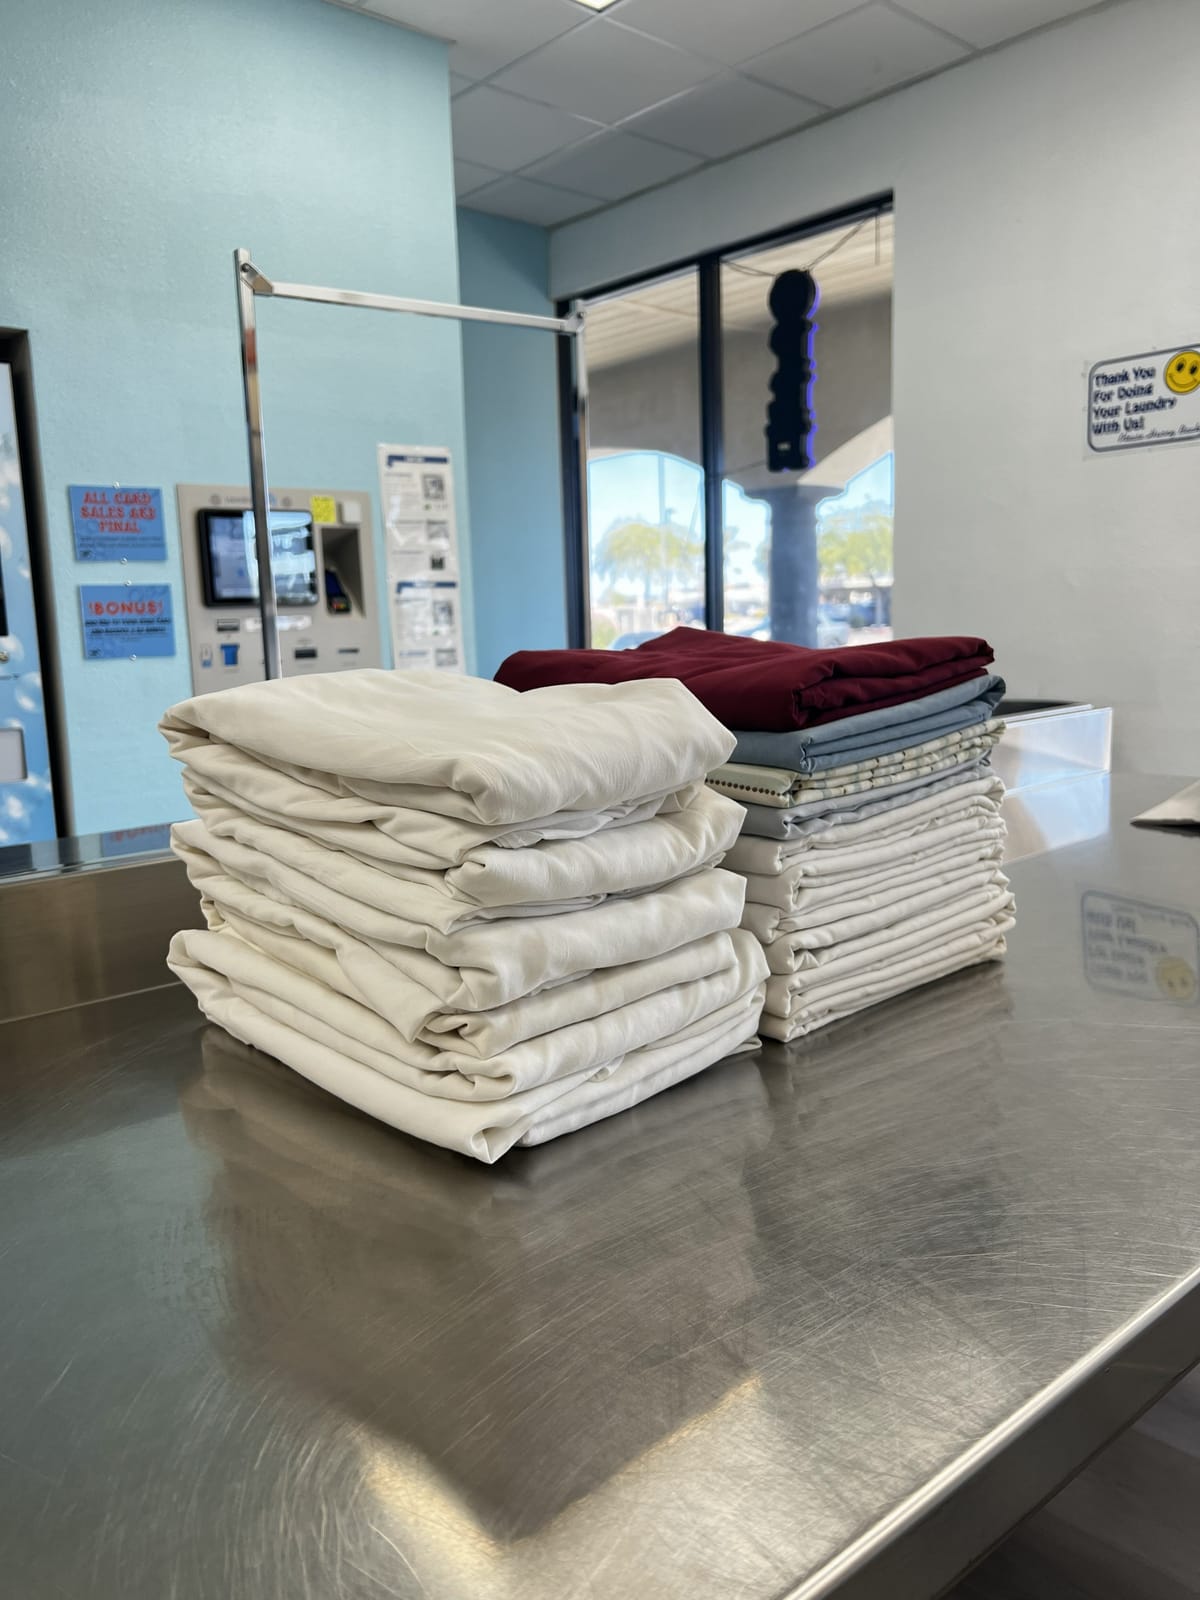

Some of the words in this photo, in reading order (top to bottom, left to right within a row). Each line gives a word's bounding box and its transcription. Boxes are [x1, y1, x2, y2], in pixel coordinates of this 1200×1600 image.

[1095, 370, 1129, 387] Thank
[1132, 367, 1156, 380] You
[1094, 390, 1114, 403] For
[1117, 383, 1154, 400] Doing
[1094, 405, 1122, 419] Your
[1125, 396, 1177, 415] Laundry
[1092, 421, 1120, 435] With
[1123, 415, 1145, 431] Us!
[83, 491, 108, 504] ALL
[114, 492, 151, 505] CARD
[80, 505, 124, 519] SALES
[98, 520, 142, 534] FINAL
